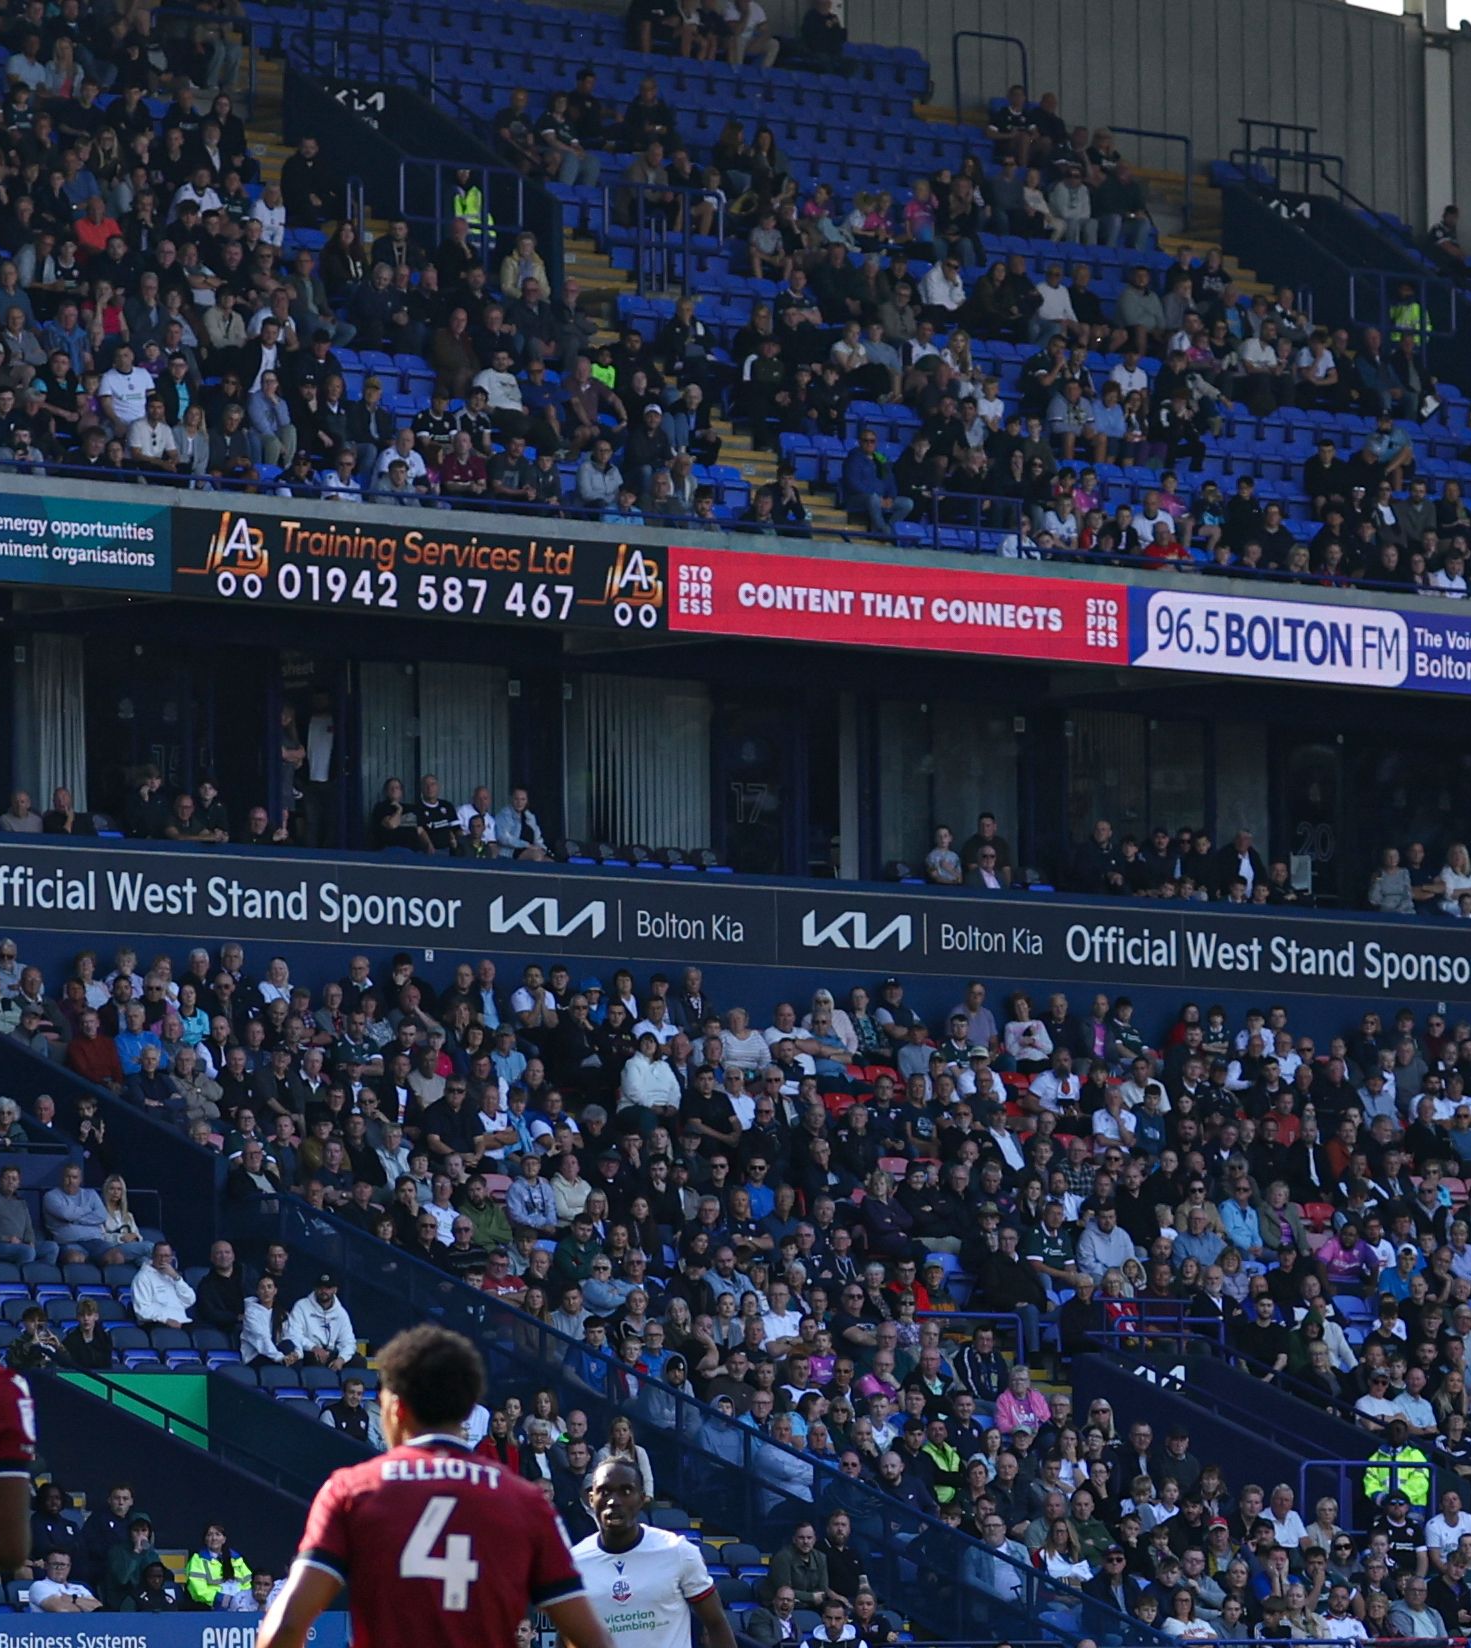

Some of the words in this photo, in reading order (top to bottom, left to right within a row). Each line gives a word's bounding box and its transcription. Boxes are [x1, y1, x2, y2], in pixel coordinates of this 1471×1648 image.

[51, 519, 154, 544] opportunities
[52, 546, 156, 568] organisations
[280, 521, 396, 572] Training
[403, 532, 522, 572] Services
[529, 542, 575, 576] Ltd
[679, 564, 712, 582] STO
[277, 563, 398, 607] 01942
[418, 575, 488, 614] 587
[505, 583, 575, 620] 467
[679, 581, 712, 599] PPR
[679, 598, 712, 616] ESS
[738, 583, 854, 615] CONTENT
[861, 592, 925, 620] THAT
[931, 598, 1063, 632] CONNECTS
[1086, 598, 1119, 616] STO
[1086, 615, 1119, 633] PPR
[1414, 627, 1444, 647] The
[1086, 631, 1119, 649] ESS
[1156, 605, 1219, 655] 96.5
[1226, 612, 1352, 668] BOLTON
[1362, 625, 1401, 672] FM
[106, 871, 197, 915] West
[207, 876, 308, 921] Stand
[319, 882, 461, 934] Sponsor
[489, 895, 606, 938] KIA
[637, 910, 706, 941] Bolton
[712, 915, 744, 943] Kia
[802, 909, 911, 952] KIA
[941, 924, 1007, 953] Bolton
[1012, 928, 1043, 956] Kia
[1066, 924, 1177, 968] Official
[1186, 931, 1262, 972] West
[1270, 936, 1354, 977] Stand
[382, 1460, 501, 1488] ELLIOTT
[400, 1497, 479, 1611] 4
[605, 1610, 655, 1624] victorian
